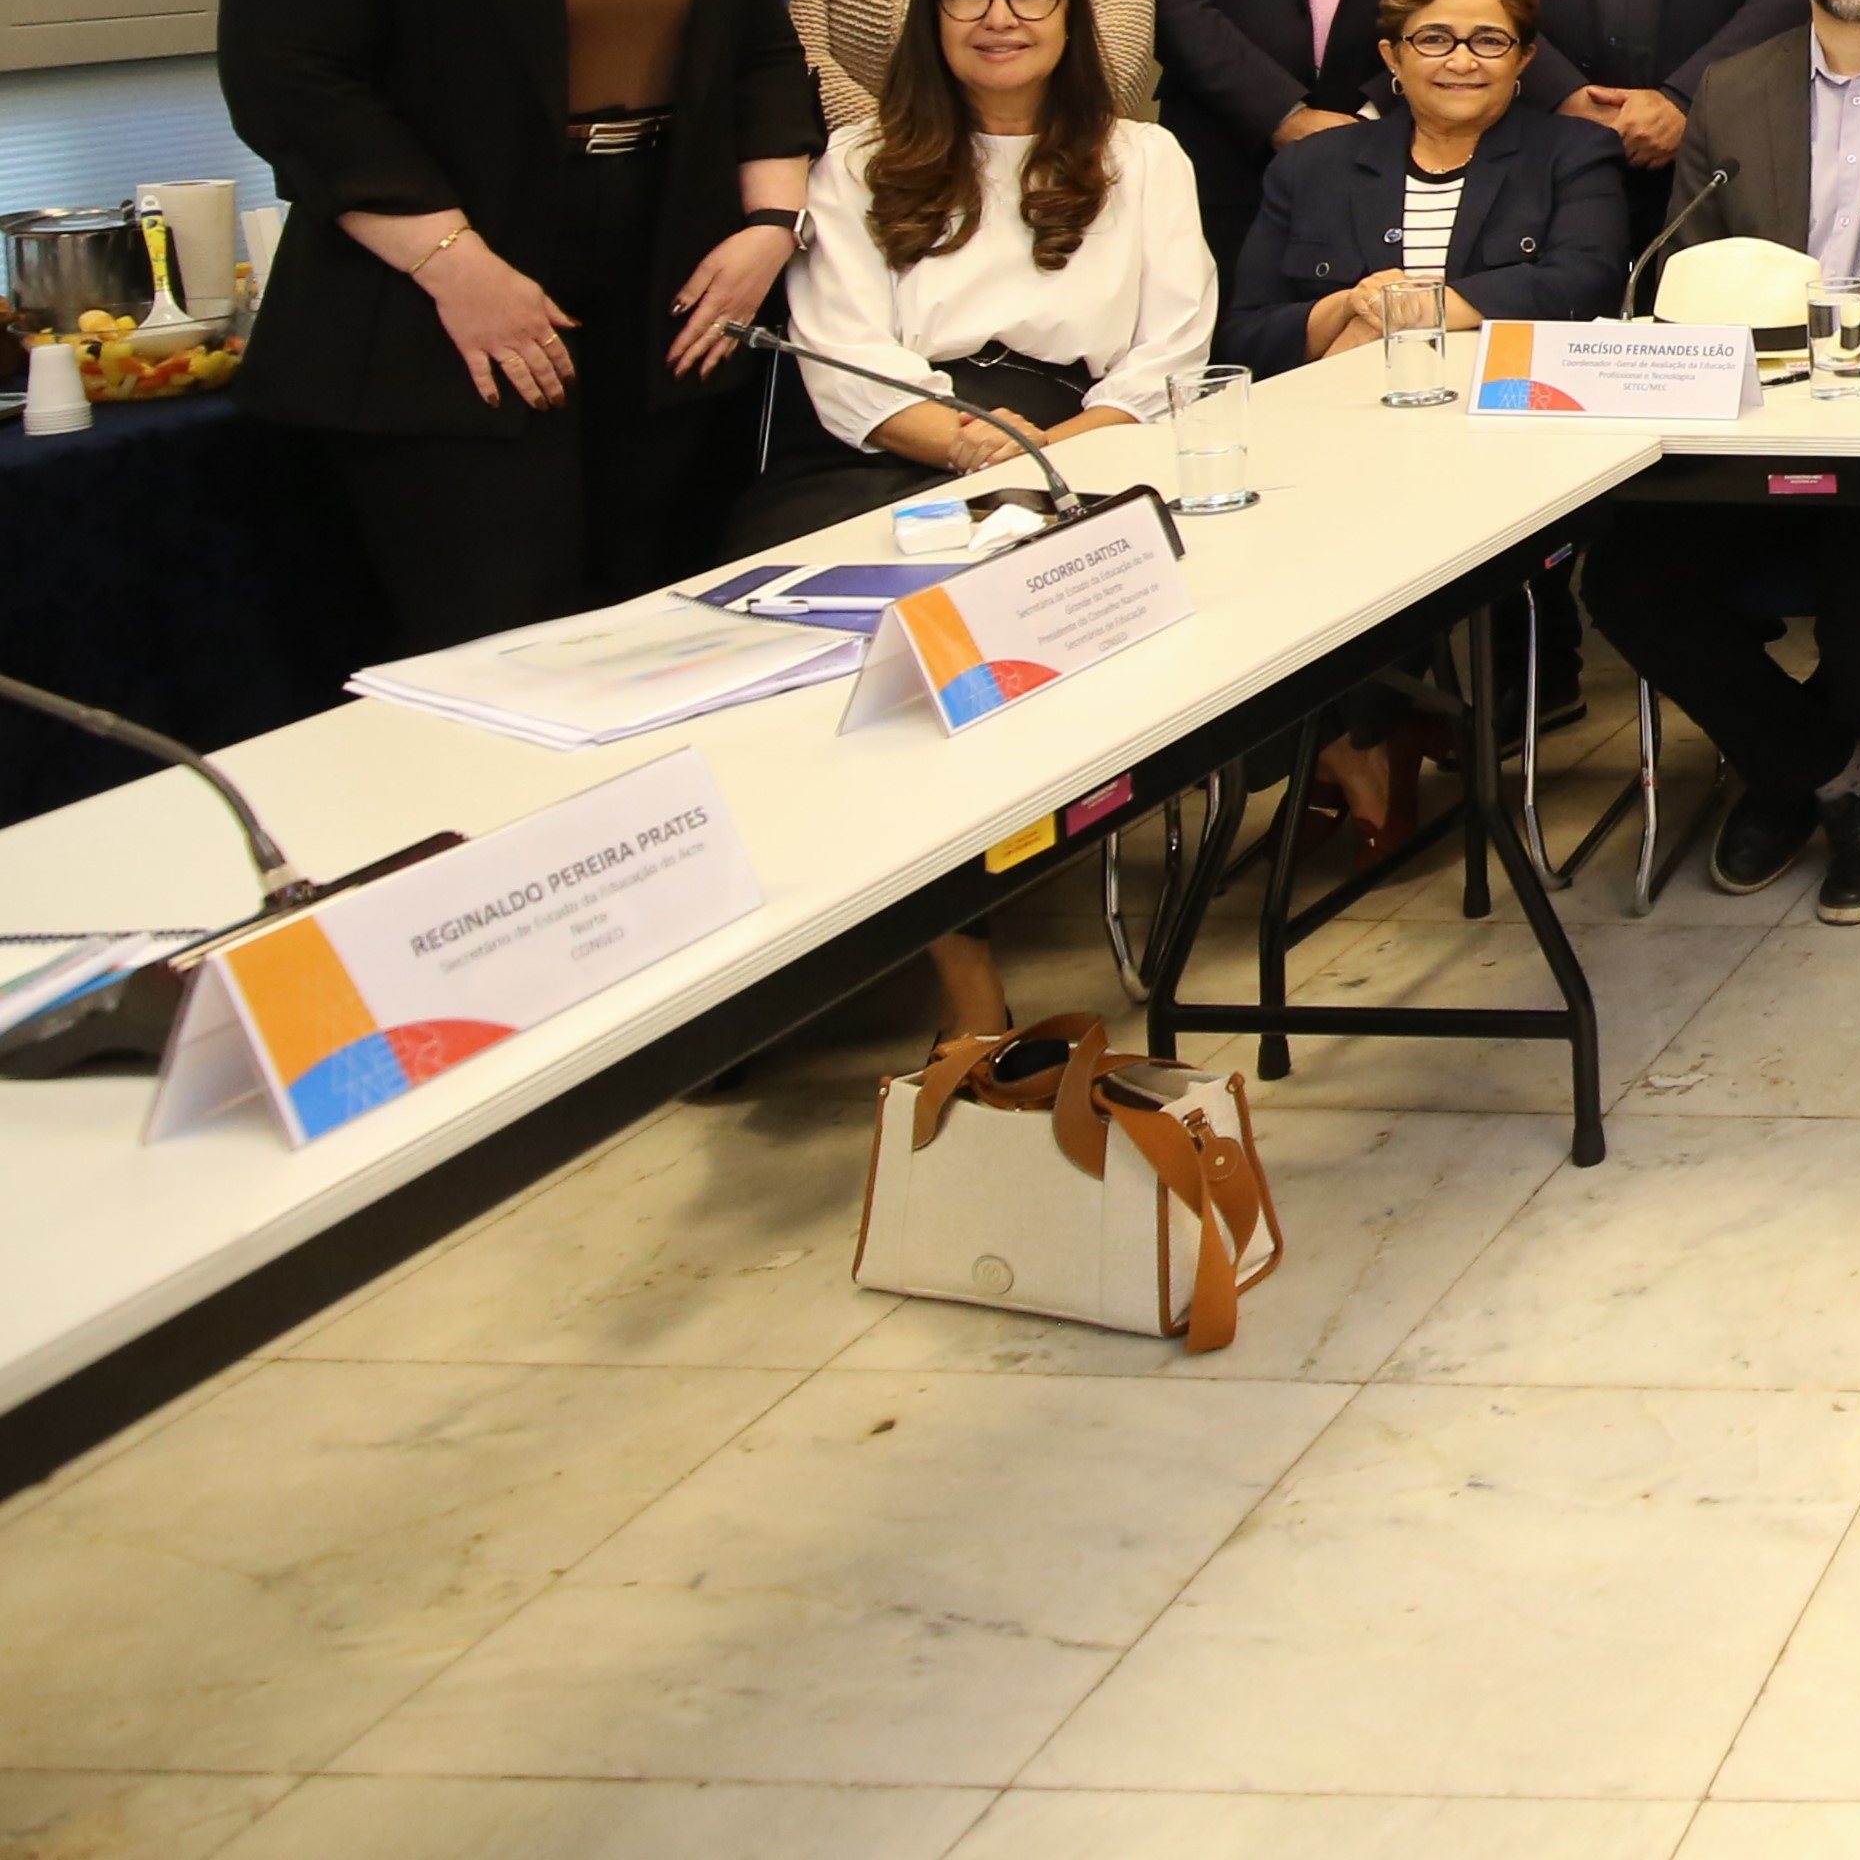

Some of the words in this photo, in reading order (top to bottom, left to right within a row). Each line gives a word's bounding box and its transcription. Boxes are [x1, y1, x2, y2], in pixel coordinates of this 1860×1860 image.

[1568, 341, 1622, 355] TARCÍSIO
[1626, 344, 1698, 356] FERNANDES
[1702, 344, 1734, 357] LEÃO
[1562, 359, 1611, 367] Coordenador
[1650, 361, 1686, 369] Avaliação
[1700, 361, 1735, 370] Educação
[1599, 371, 1642, 380] Profissional
[1651, 372, 1695, 381] Tecnológica
[1623, 383, 1667, 391] SETEC/MEC
[1026, 558, 1085, 593] SOCORRO
[1085, 538, 1130, 567] BATISTA
[1055, 592, 1064, 602] de
[1065, 581, 1090, 597] Estado
[1090, 576, 1100, 585] da
[1100, 561, 1132, 581] Educação
[1132, 557, 1142, 566] do
[1065, 597, 1092, 614] Grande
[1092, 592, 1103, 602] do
[1102, 583, 1123, 596] Norte
[1037, 622, 1077, 645] Presidente
[1077, 617, 1088, 627] do
[1088, 602, 1120, 621] Conselho
[1120, 587, 1150, 605] Nacional
[1149, 583, 1158, 592] de
[1105, 621, 1114, 631] de
[1114, 606, 1147, 627] Educação
[411, 883, 543, 956] REGINALDO
[548, 842, 634, 892] PEREIRA
[636, 807, 707, 851] PRATES
[439, 934, 511, 973] Secretário
[514, 924, 531, 938] de
[533, 902, 579, 928] Estado
[581, 893, 598, 906] da
[599, 864, 658, 896] Educação
[660, 855, 676, 868] do
[678, 842, 704, 859] Acre
[570, 913, 607, 935] Norte
[571, 928, 624, 957] CONSED
